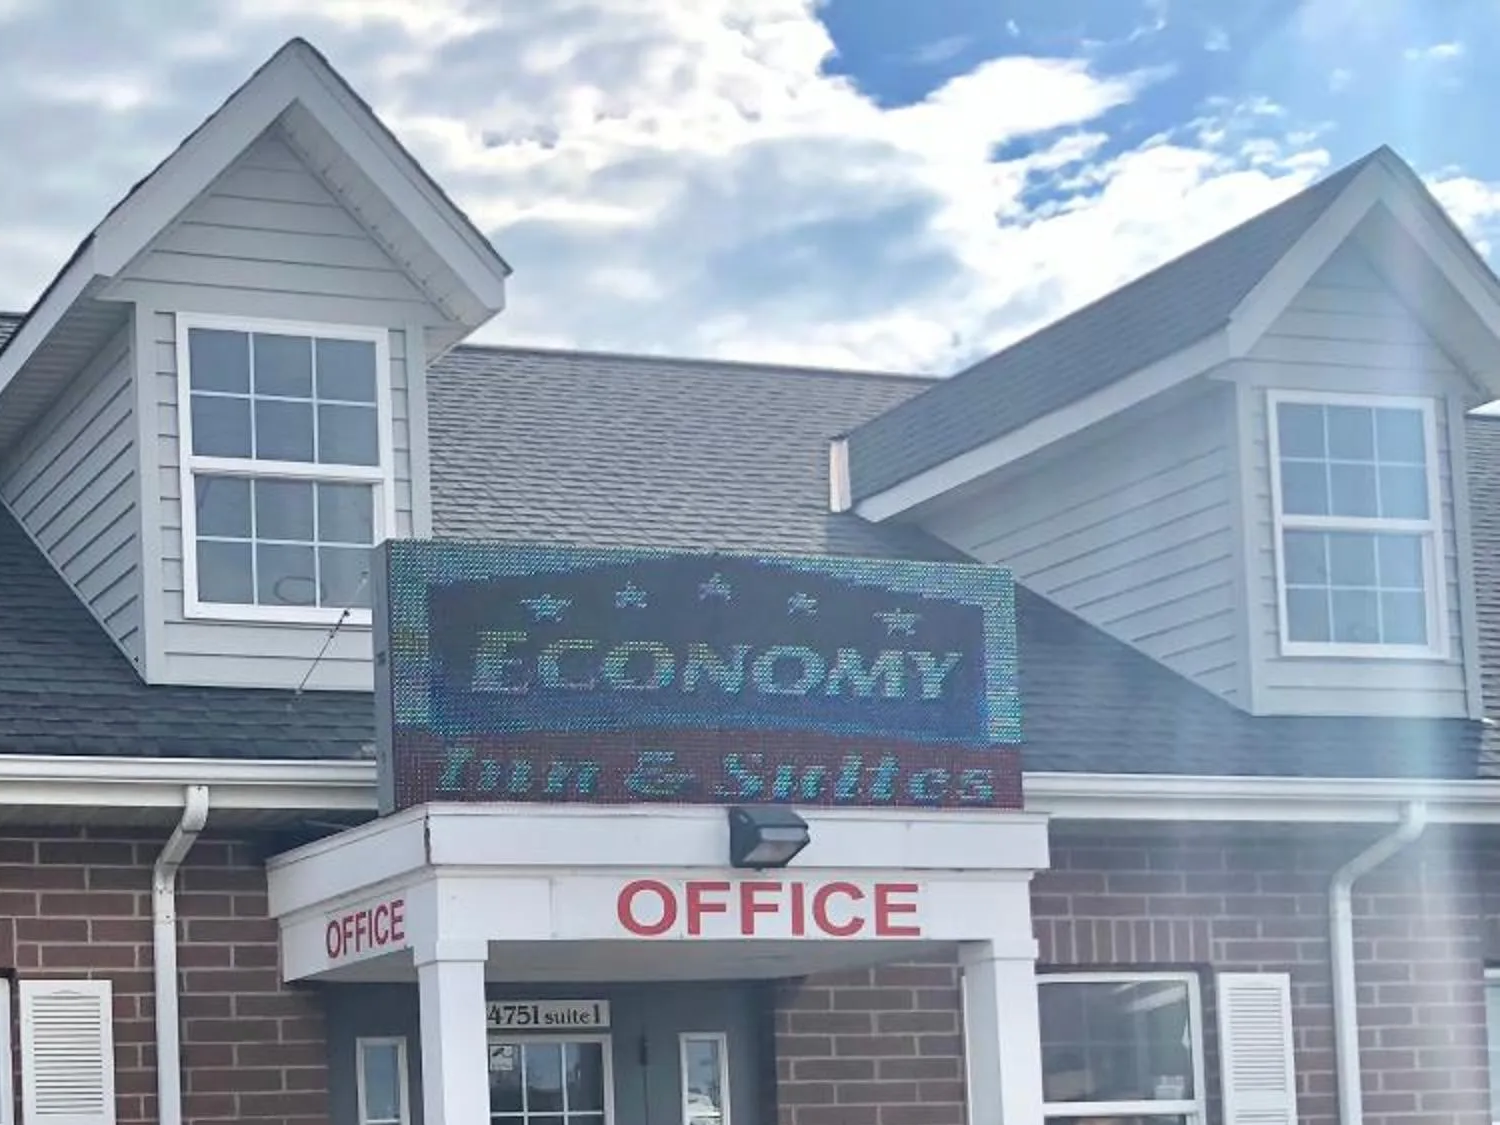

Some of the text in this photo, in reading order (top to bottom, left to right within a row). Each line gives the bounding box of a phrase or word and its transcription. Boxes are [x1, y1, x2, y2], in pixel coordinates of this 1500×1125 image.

[471, 630, 963, 699] ECONOMY
[435, 747, 993, 800] Inn & Suites
[325, 898, 405, 960] OFFICE
[616, 879, 921, 937] OFFICE
[487, 1004, 540, 1025] 4751
[544, 1008, 590, 1025] suite
